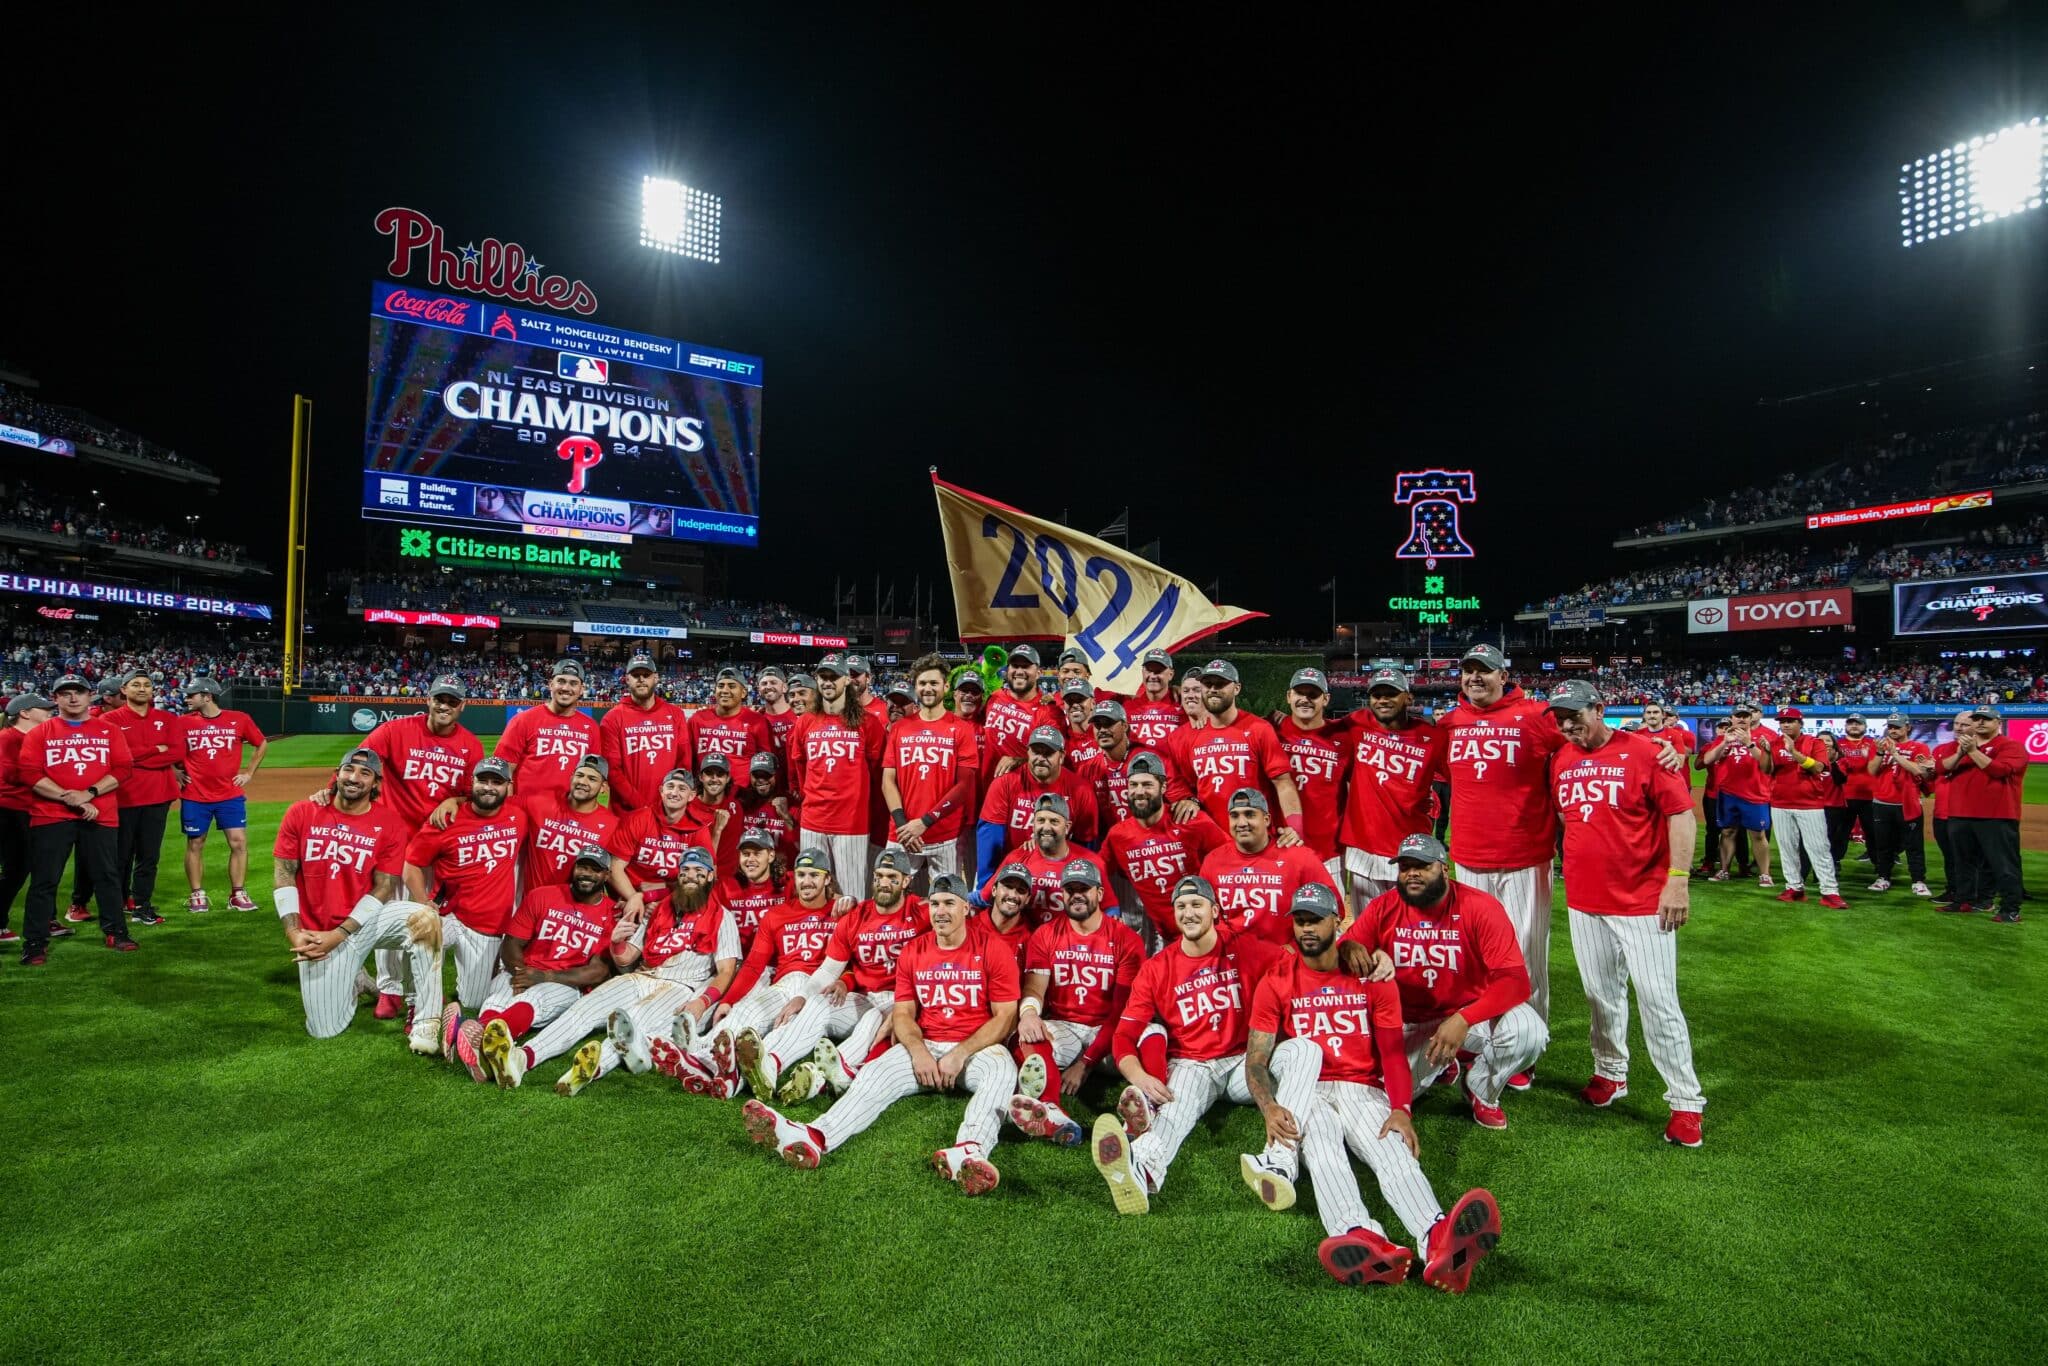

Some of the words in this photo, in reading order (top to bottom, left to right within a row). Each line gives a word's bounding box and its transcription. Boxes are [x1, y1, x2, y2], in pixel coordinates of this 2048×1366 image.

[374, 207, 597, 314] Phillies
[520, 318, 551, 332] SALTZ
[556, 325, 620, 345] MONGELUZZI
[624, 338, 672, 355] BENDESKY
[551, 337, 590, 351] INJURY
[598, 346, 644, 361] LAWYERS
[487, 370, 515, 387] NL
[522, 377, 576, 396] EAST
[583, 386, 670, 412] DIVISION
[443, 381, 704, 453] CHAMPIONS
[517, 428, 547, 444] 20
[613, 442, 640, 457] 24
[420, 482, 457, 496] Building
[420, 491, 445, 501] brave
[528, 503, 626, 527] CHAMPIONS
[578, 504, 613, 513] DIVISION
[1821, 512, 1858, 525] Phillies
[1883, 507, 1905, 519] you
[1906, 503, 1931, 513] win!
[678, 518, 744, 534] Independence
[435, 536, 521, 560] Citizens
[525, 544, 575, 565] Bank
[579, 549, 622, 570] Park
[93, 585, 175, 607] PHILLIES
[186, 598, 236, 614] 2024
[982, 512, 1180, 682] 2024
[1389, 597, 1443, 611] Citizens
[1445, 596, 1480, 610] Bank
[1926, 593, 2045, 610] CHAMPIONS
[368, 611, 383, 622] JIM
[384, 610, 406, 624] BEAM
[416, 613, 431, 625] JIM
[431, 612, 452, 626] BEAM
[1419, 611, 1449, 624] Park
[1735, 598, 1841, 623] TOYOTA
[462, 616, 476, 627] JIM
[477, 615, 496, 628] BEAM
[591, 623, 631, 634] LISCIO'S
[634, 626, 671, 636] BAKERY
[766, 634, 798, 644] TOYOTA
[814, 638, 845, 647] TOYOTA
[317, 703, 336, 713] 334
[553, 729, 574, 738] OWN
[575, 732, 589, 740] THE
[638, 725, 657, 733] OWN
[658, 724, 674, 732] THE
[985, 711, 1030, 740] EAST
[1454, 728, 1468, 737] WE
[1469, 727, 1495, 736] OWN
[1497, 727, 1521, 737] THE
[46, 739, 64, 747] WE
[65, 738, 90, 746] OWN
[91, 738, 109, 746] THE
[188, 735, 236, 751] EAST
[536, 738, 589, 759] EAST
[625, 733, 675, 755] EAST
[698, 737, 747, 756] EAST
[807, 741, 860, 760] EAST
[901, 736, 915, 744] WE
[915, 735, 936, 743] OWN
[937, 736, 954, 745] THE
[1194, 746, 1207, 755] WE
[1207, 744, 1230, 753] OWN
[1231, 743, 1249, 751] THE
[46, 747, 110, 768] EAST
[900, 746, 954, 768] EAST
[1071, 747, 1103, 763] Philli
[1356, 742, 1423, 781] EAST
[1450, 739, 1521, 764] EAST
[403, 759, 464, 787] EAST
[1192, 755, 1250, 778] EAST
[1290, 753, 1338, 779] AST
[1559, 770, 1572, 780] WE
[1573, 767, 1599, 777] OWN
[1600, 767, 1625, 777] THE
[1559, 779, 1625, 807] EAST
[310, 826, 329, 836] WE
[331, 828, 353, 842] OWN
[354, 835, 376, 847] THE
[458, 834, 476, 845] WE
[476, 830, 500, 842] OWN
[502, 827, 517, 837] THE
[305, 838, 372, 872] EAST
[458, 838, 518, 867] EAST
[637, 847, 681, 868] EAS
[1127, 849, 1141, 860] WE
[1141, 844, 1166, 856] OWN
[1167, 841, 1183, 851] THE
[1127, 852, 1187, 882] EAST
[1217, 874, 1234, 884] WE
[1235, 874, 1261, 884] OWN
[1262, 874, 1282, 884] THE
[1217, 887, 1283, 914] EAST
[548, 908, 563, 920] WE
[563, 914, 584, 928] OWN
[585, 922, 603, 935] THE
[538, 919, 599, 955] EAST
[1395, 927, 1412, 938] WE
[1413, 928, 1439, 940] OWN
[1440, 928, 1460, 941] THE
[1393, 941, 1462, 971] EAST
[915, 971, 933, 981] WE
[934, 970, 959, 980] OWN
[960, 970, 981, 980] THE
[1174, 981, 1192, 995] WE
[1194, 974, 1218, 990] OWN
[1219, 968, 1239, 981] THE
[915, 984, 982, 1007] EAST
[1176, 983, 1242, 1027] EAST
[1291, 997, 1311, 1009] WE
[1312, 995, 1343, 1007] OWN
[1344, 993, 1367, 1005] THE
[1291, 1008, 1371, 1039] EAST
